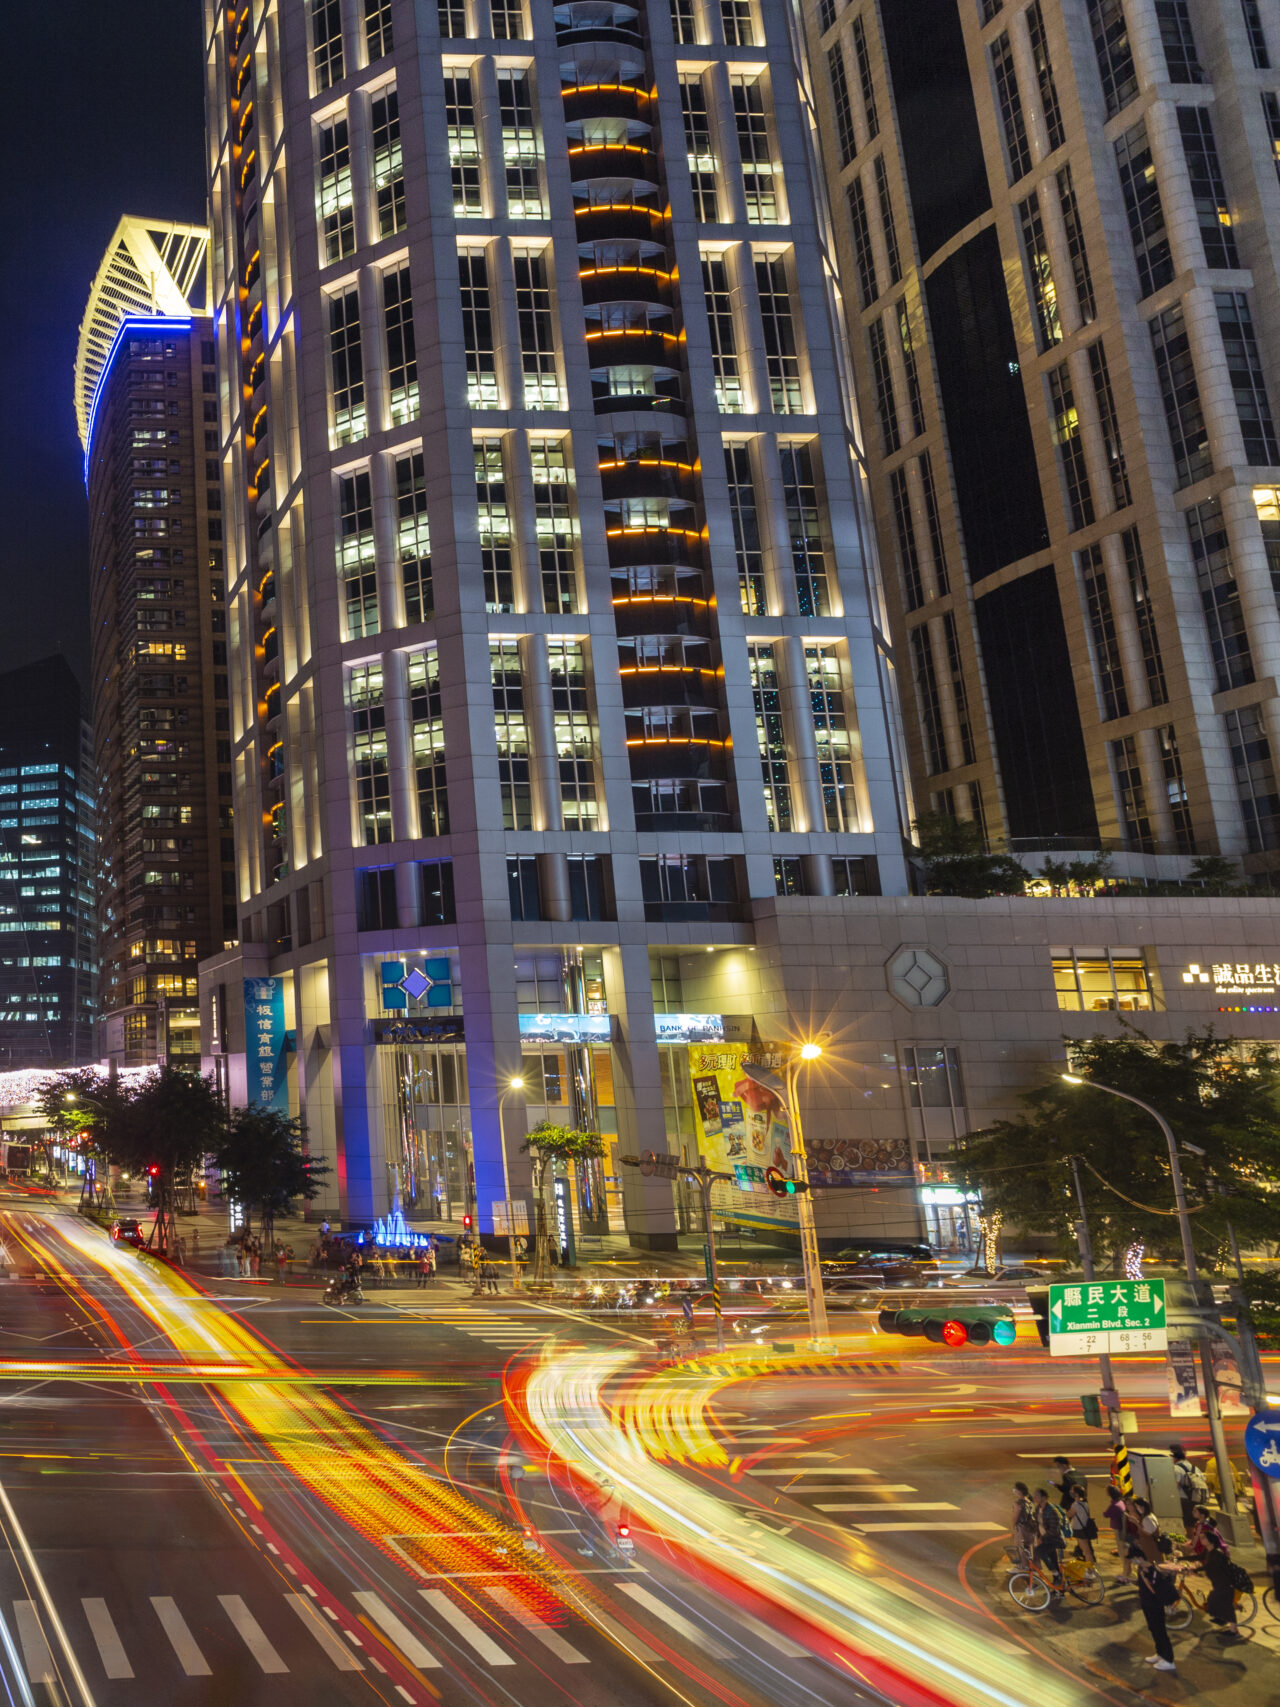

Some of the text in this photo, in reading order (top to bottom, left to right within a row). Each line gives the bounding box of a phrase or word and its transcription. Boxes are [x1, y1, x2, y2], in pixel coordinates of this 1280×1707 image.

[1063, 1284, 1151, 1307] 縣民大道
[1087, 1306, 1128, 1318] 二段
[1067, 1318, 1150, 1330] Xianmin Blvd. Sec. 2
[1086, 1335, 1096, 1343] 22
[1120, 1333, 1130, 1341] 68
[1142, 1332, 1152, 1340] 56
[1087, 1344, 1092, 1352] 7
[1125, 1342, 1130, 1350] 3
